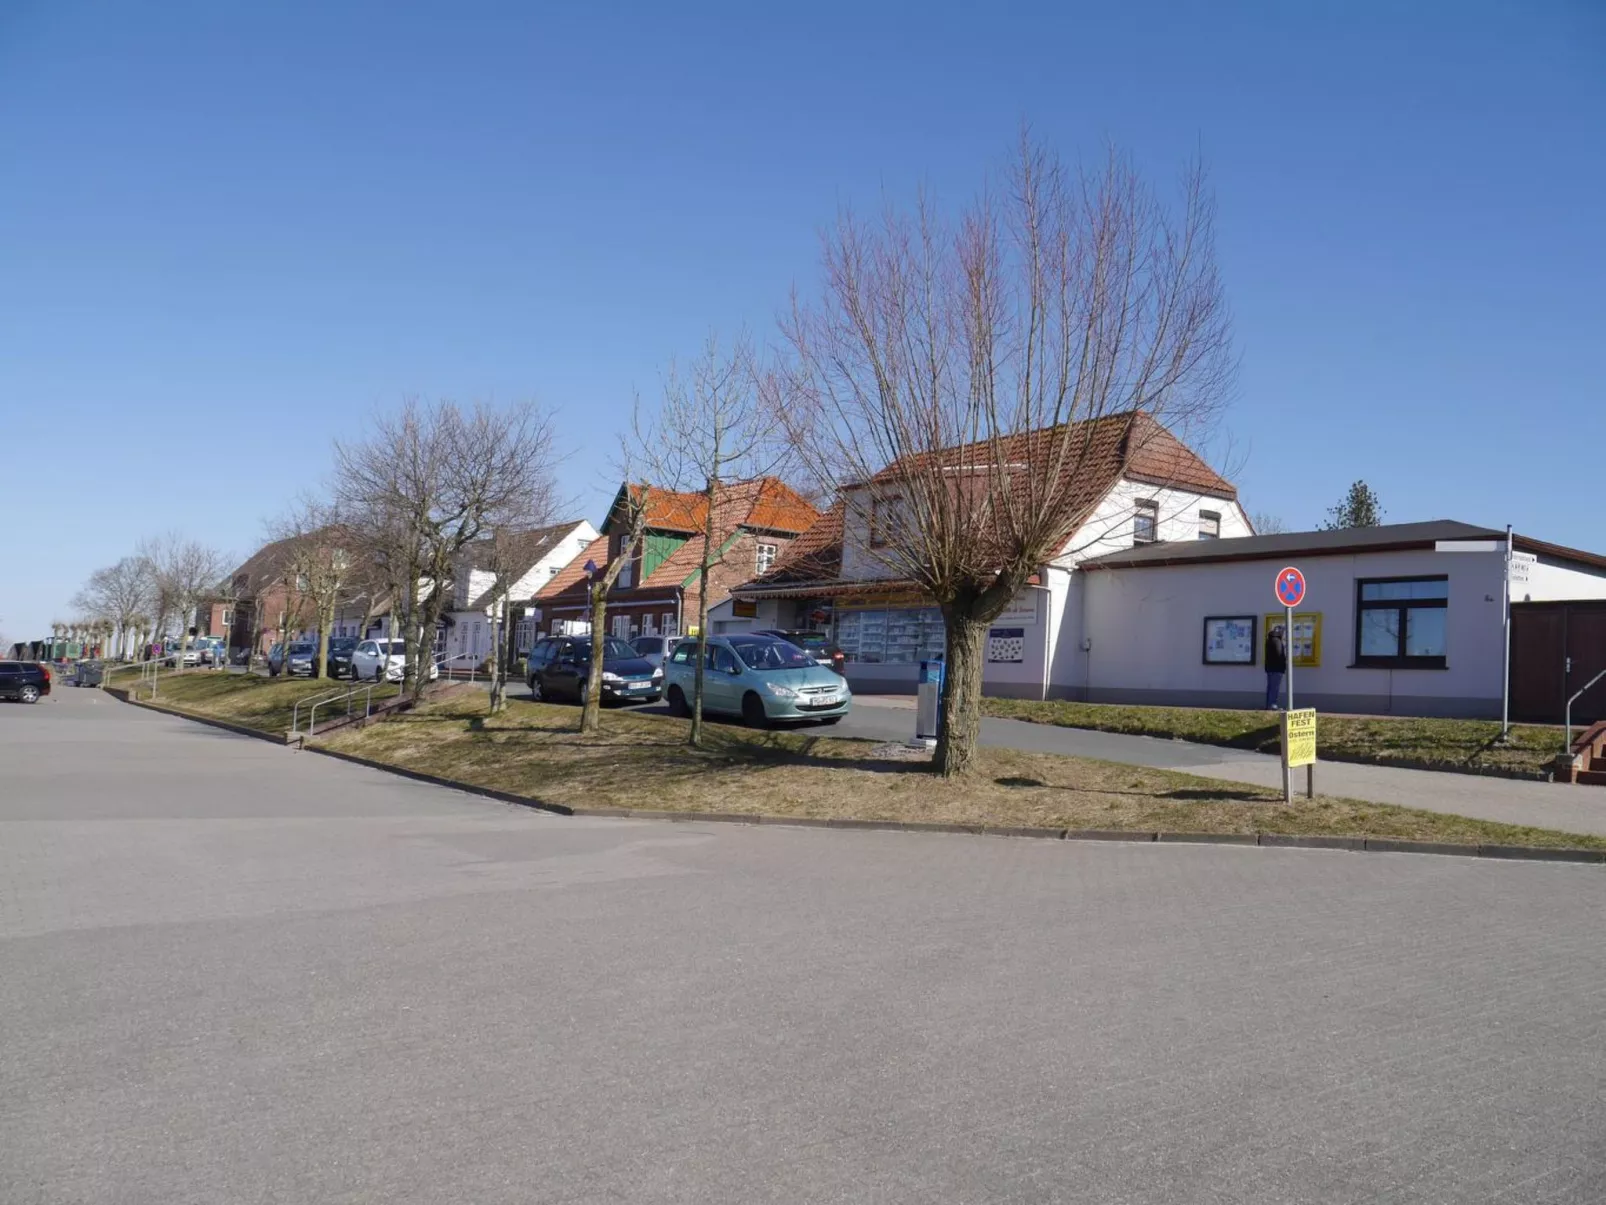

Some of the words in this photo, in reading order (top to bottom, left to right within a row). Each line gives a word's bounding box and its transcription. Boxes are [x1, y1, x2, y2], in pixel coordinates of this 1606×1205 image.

[1287, 711, 1314, 720] HAFEN
[1291, 719, 1311, 727] FEST
[1289, 730, 1314, 738] Ostern
